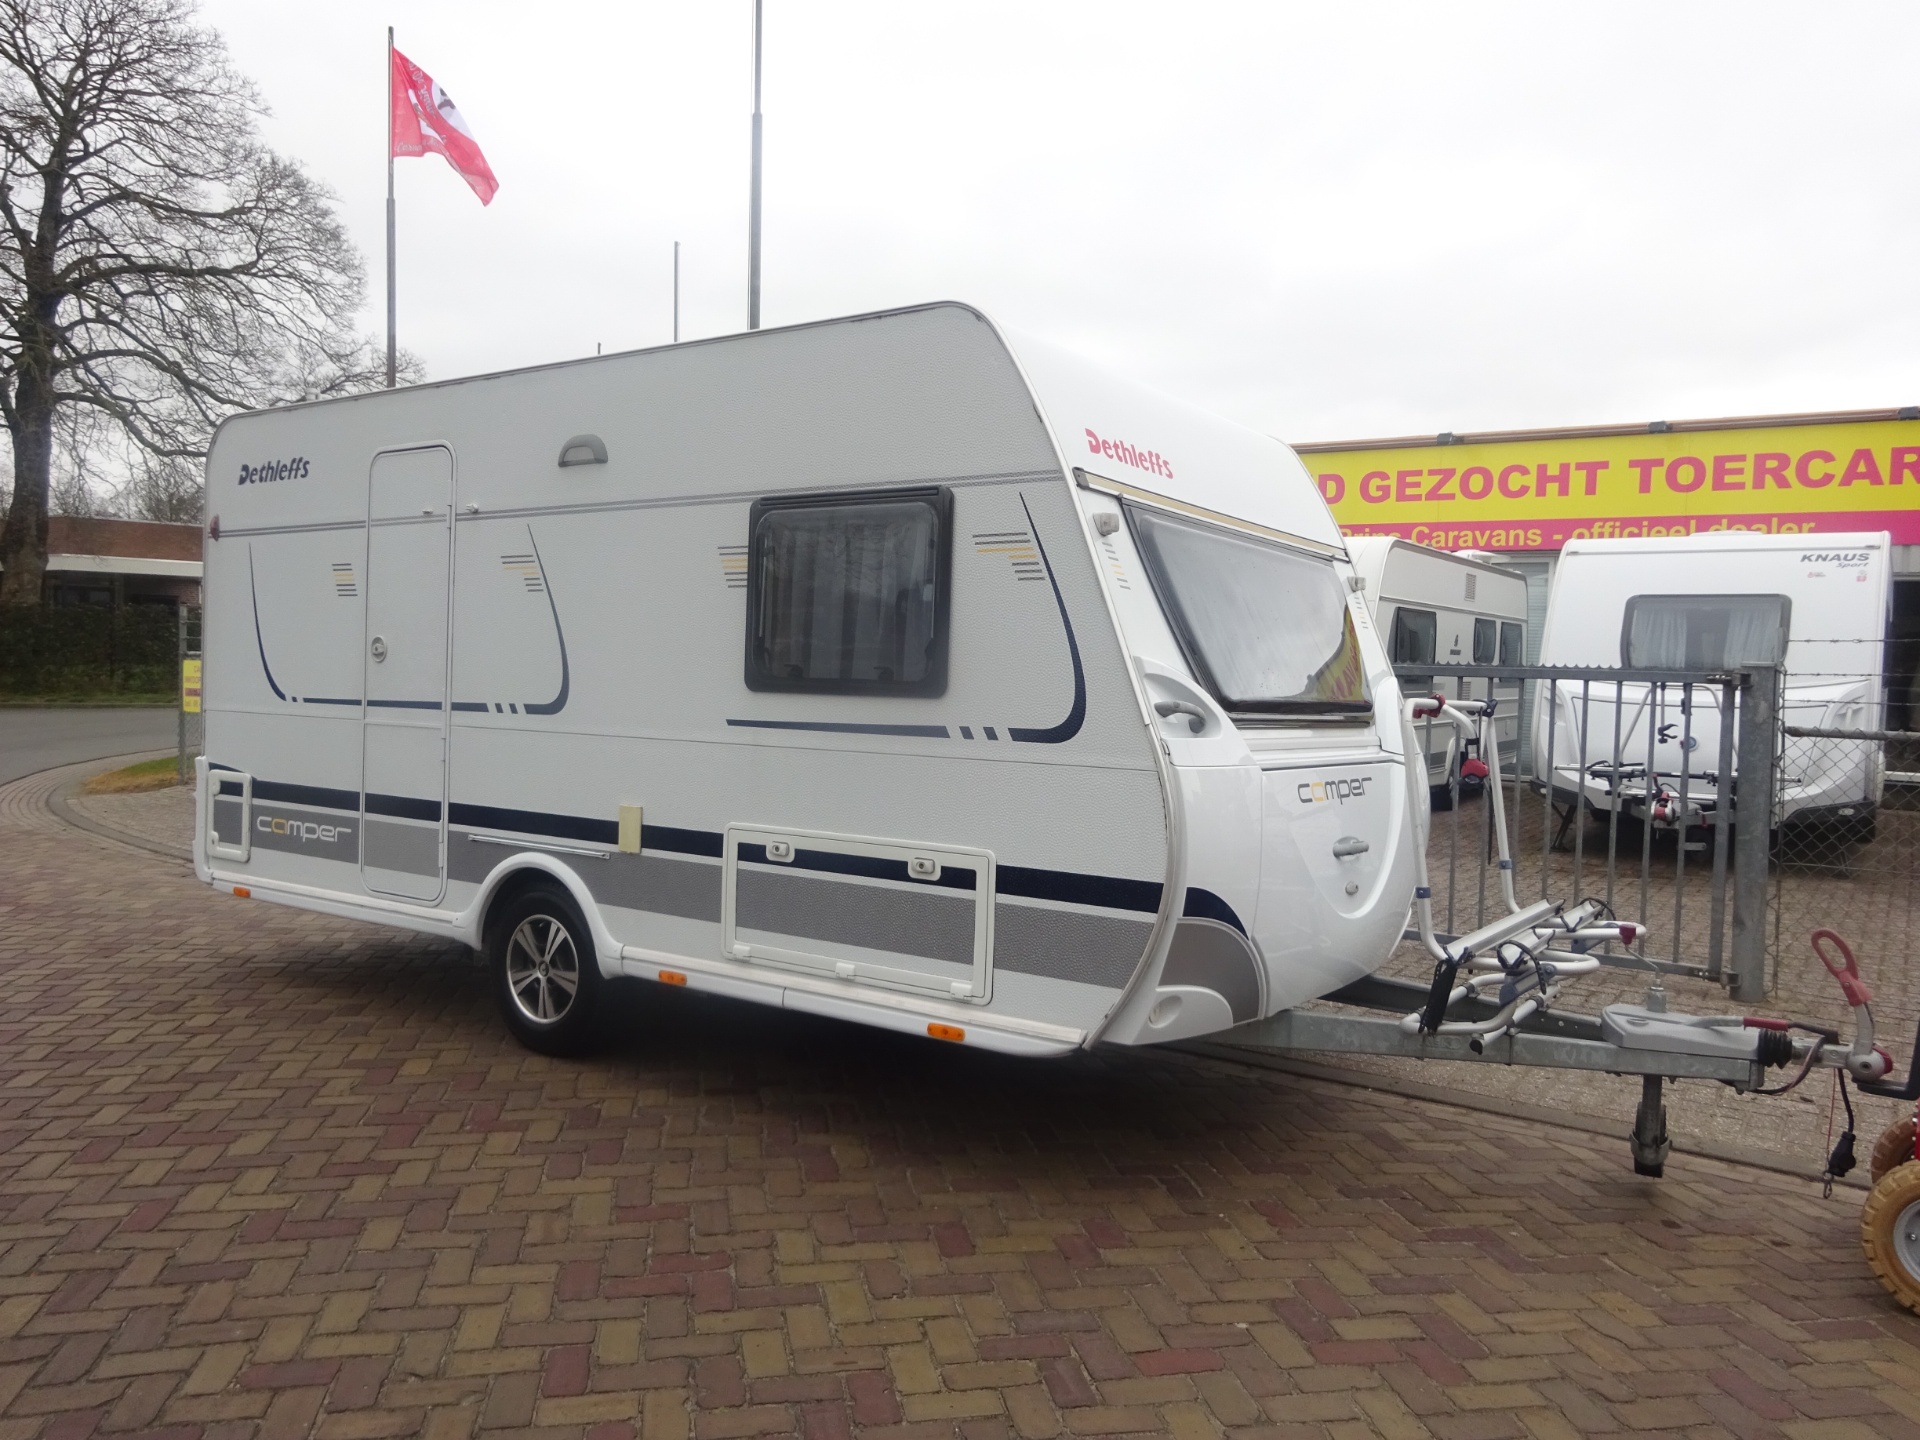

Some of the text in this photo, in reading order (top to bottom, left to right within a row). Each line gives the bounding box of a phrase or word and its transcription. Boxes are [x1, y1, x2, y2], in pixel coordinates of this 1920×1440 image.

[1085, 427, 1174, 480] Dethleffs
[238, 456, 311, 486] Dethleffs
[1359, 460, 1610, 504] GEZOCHT
[1628, 445, 1920, 494] TOERCAR
[1411, 526, 1543, 548] Caravans
[1800, 552, 1871, 563] KNAUS
[1297, 776, 1373, 805] camper
[257, 815, 352, 843] camper
